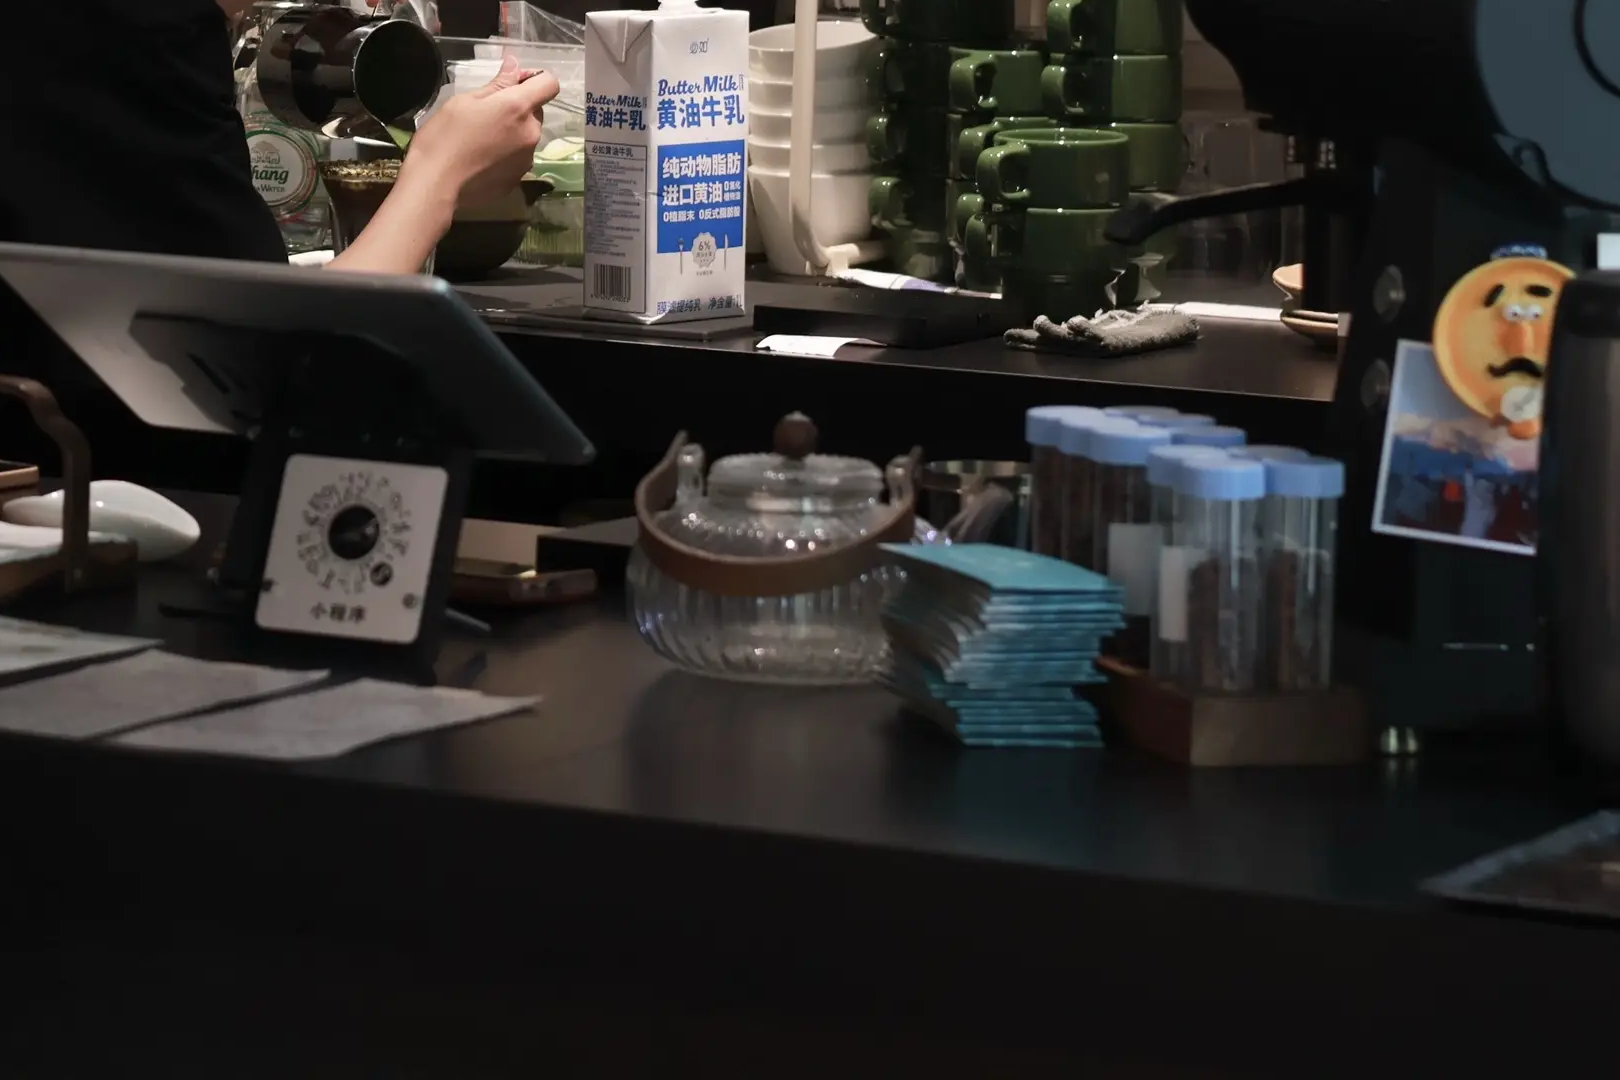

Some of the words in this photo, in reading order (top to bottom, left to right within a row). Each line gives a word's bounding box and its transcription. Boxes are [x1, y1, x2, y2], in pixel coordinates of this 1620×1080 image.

[658, 79, 702, 97] Butter
[703, 75, 739, 93] Milk
[586, 92, 616, 106] Butter
[616, 95, 642, 108] Milk
[585, 106, 646, 130] 黄油牛乳
[657, 95, 745, 130] 黄油牛乳
[251, 166, 289, 184] hang
[662, 152, 741, 179] 纯动物脂肪
[662, 181, 722, 206] 进口黄油
[698, 240, 711, 251] 6%
[310, 602, 366, 624] 小程序
